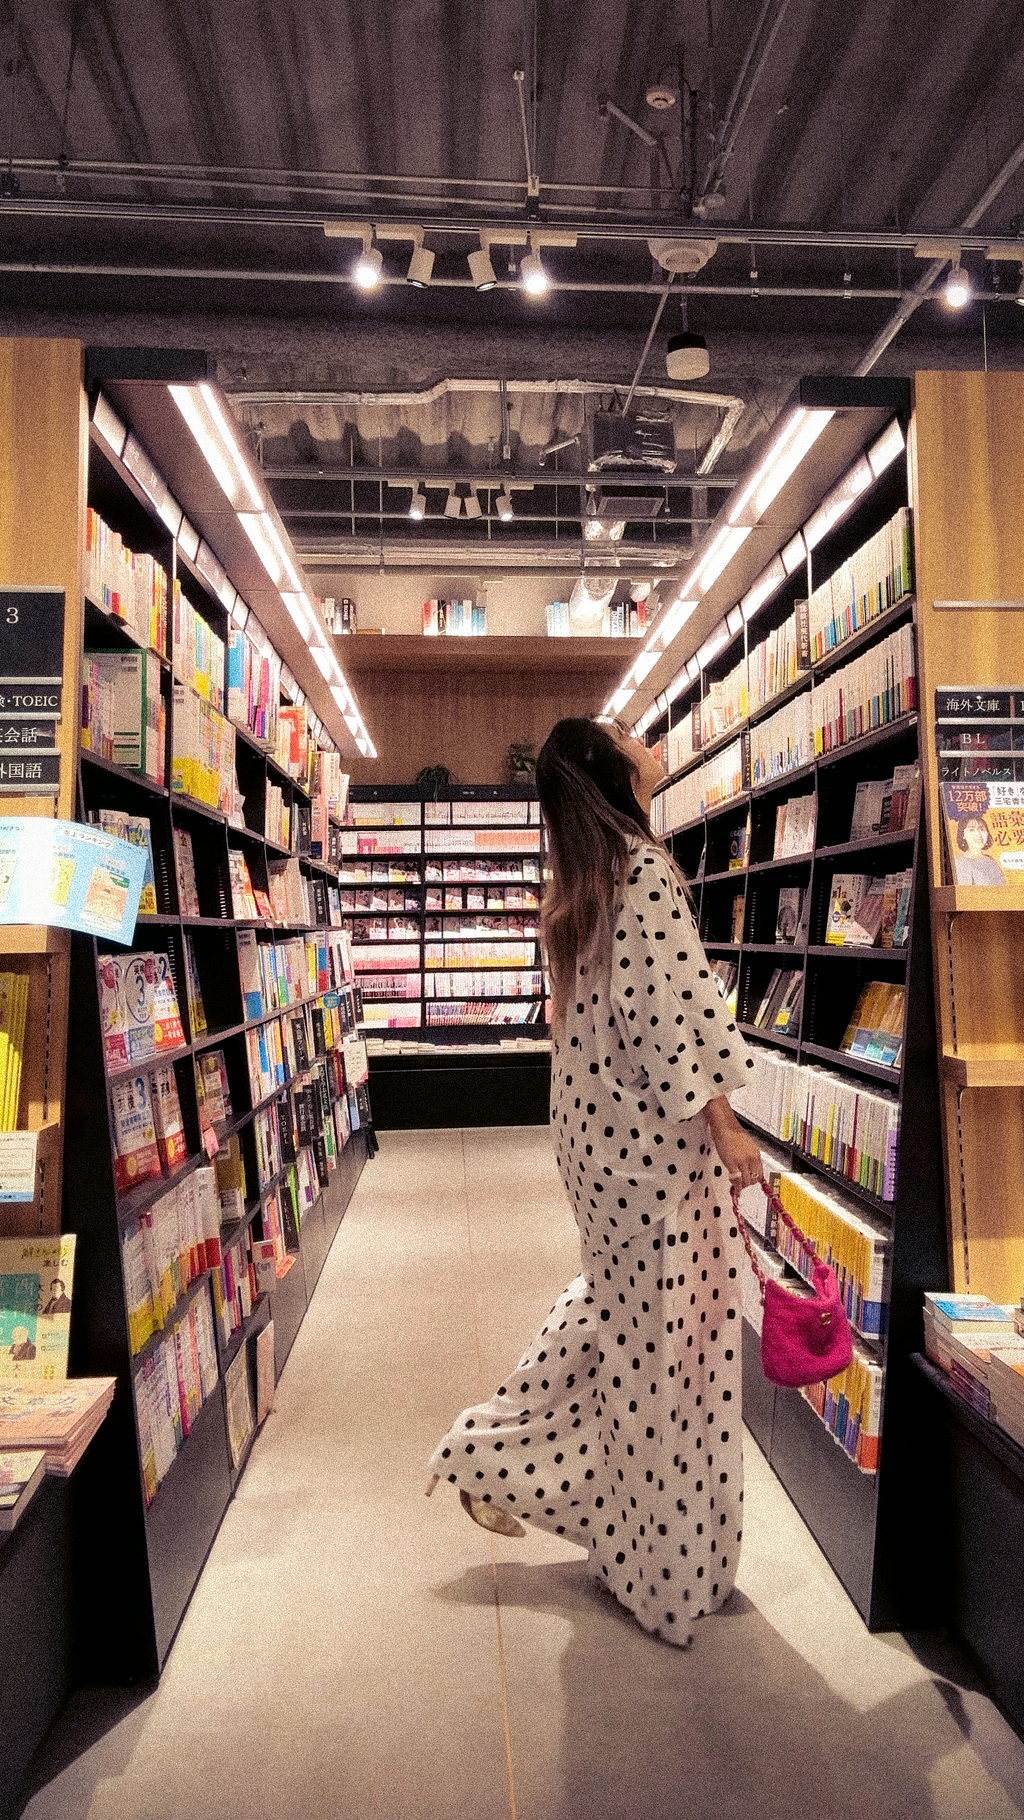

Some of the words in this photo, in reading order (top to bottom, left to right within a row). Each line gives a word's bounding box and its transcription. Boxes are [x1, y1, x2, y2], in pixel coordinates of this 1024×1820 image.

[6, 607, 19, 624] 3
[0, 695, 58, 707] ・TOEIC
[946, 698, 1000, 712] 海外文庫
[0, 727, 38, 743] 会話
[941, 767, 1012, 777] ライトノベルス
